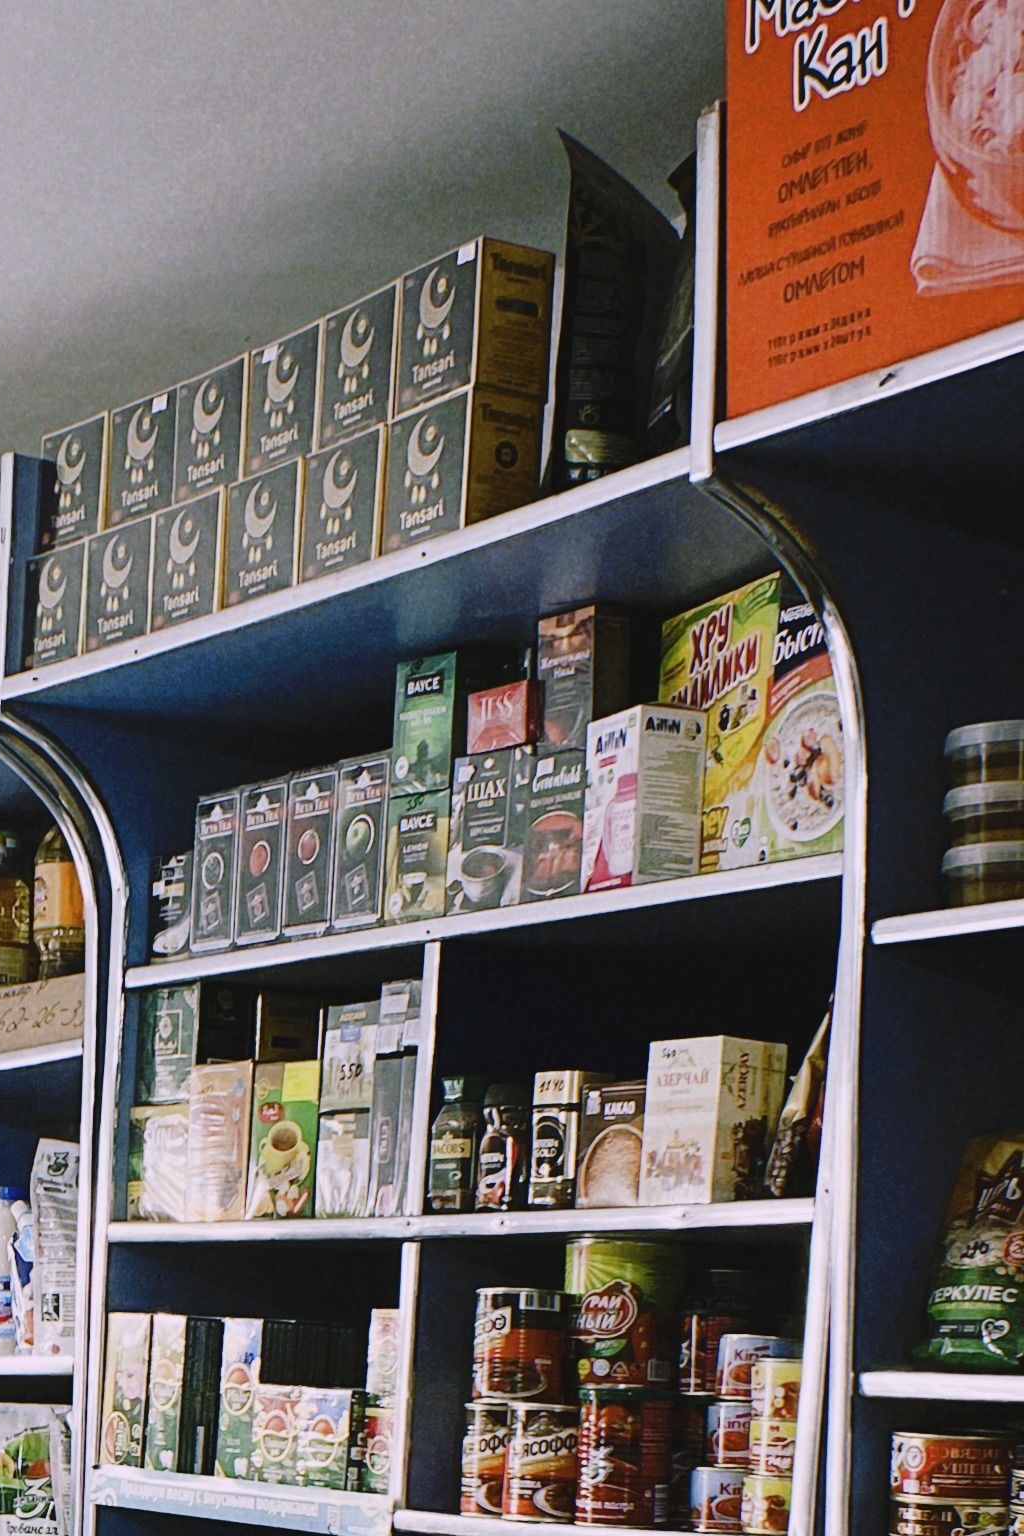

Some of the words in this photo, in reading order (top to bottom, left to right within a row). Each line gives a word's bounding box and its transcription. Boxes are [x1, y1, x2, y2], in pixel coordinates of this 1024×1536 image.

[794, 18, 887, 109] Кан
[783, 254, 866, 304] ОМЛЕТОМ
[411, 354, 455, 384] Tansari
[333, 390, 374, 421] Tansari
[259, 427, 299, 456] Tansari
[186, 454, 226, 482] Tansari
[121, 481, 160, 507] Tansari
[398, 501, 445, 532] Tansari
[314, 532, 358, 561] Tansari
[238, 561, 279, 588] Tansari
[162, 590, 200, 614] Tansari
[96, 610, 134, 634] Tansari
[406, 677, 442, 695] BAYCE
[479, 691, 514, 720] TESS
[467, 777, 507, 803] ШАХ
[532, 763, 582, 794] Greenfield
[399, 812, 435, 833] BAYCE
[656, 1067, 709, 1088] АЗЕРЧАЙ
[603, 1101, 636, 1116] КАКАО
[432, 1141, 465, 1153] JACOBS
[930, 1285, 1019, 1304] ГЕРКУЛЕС
